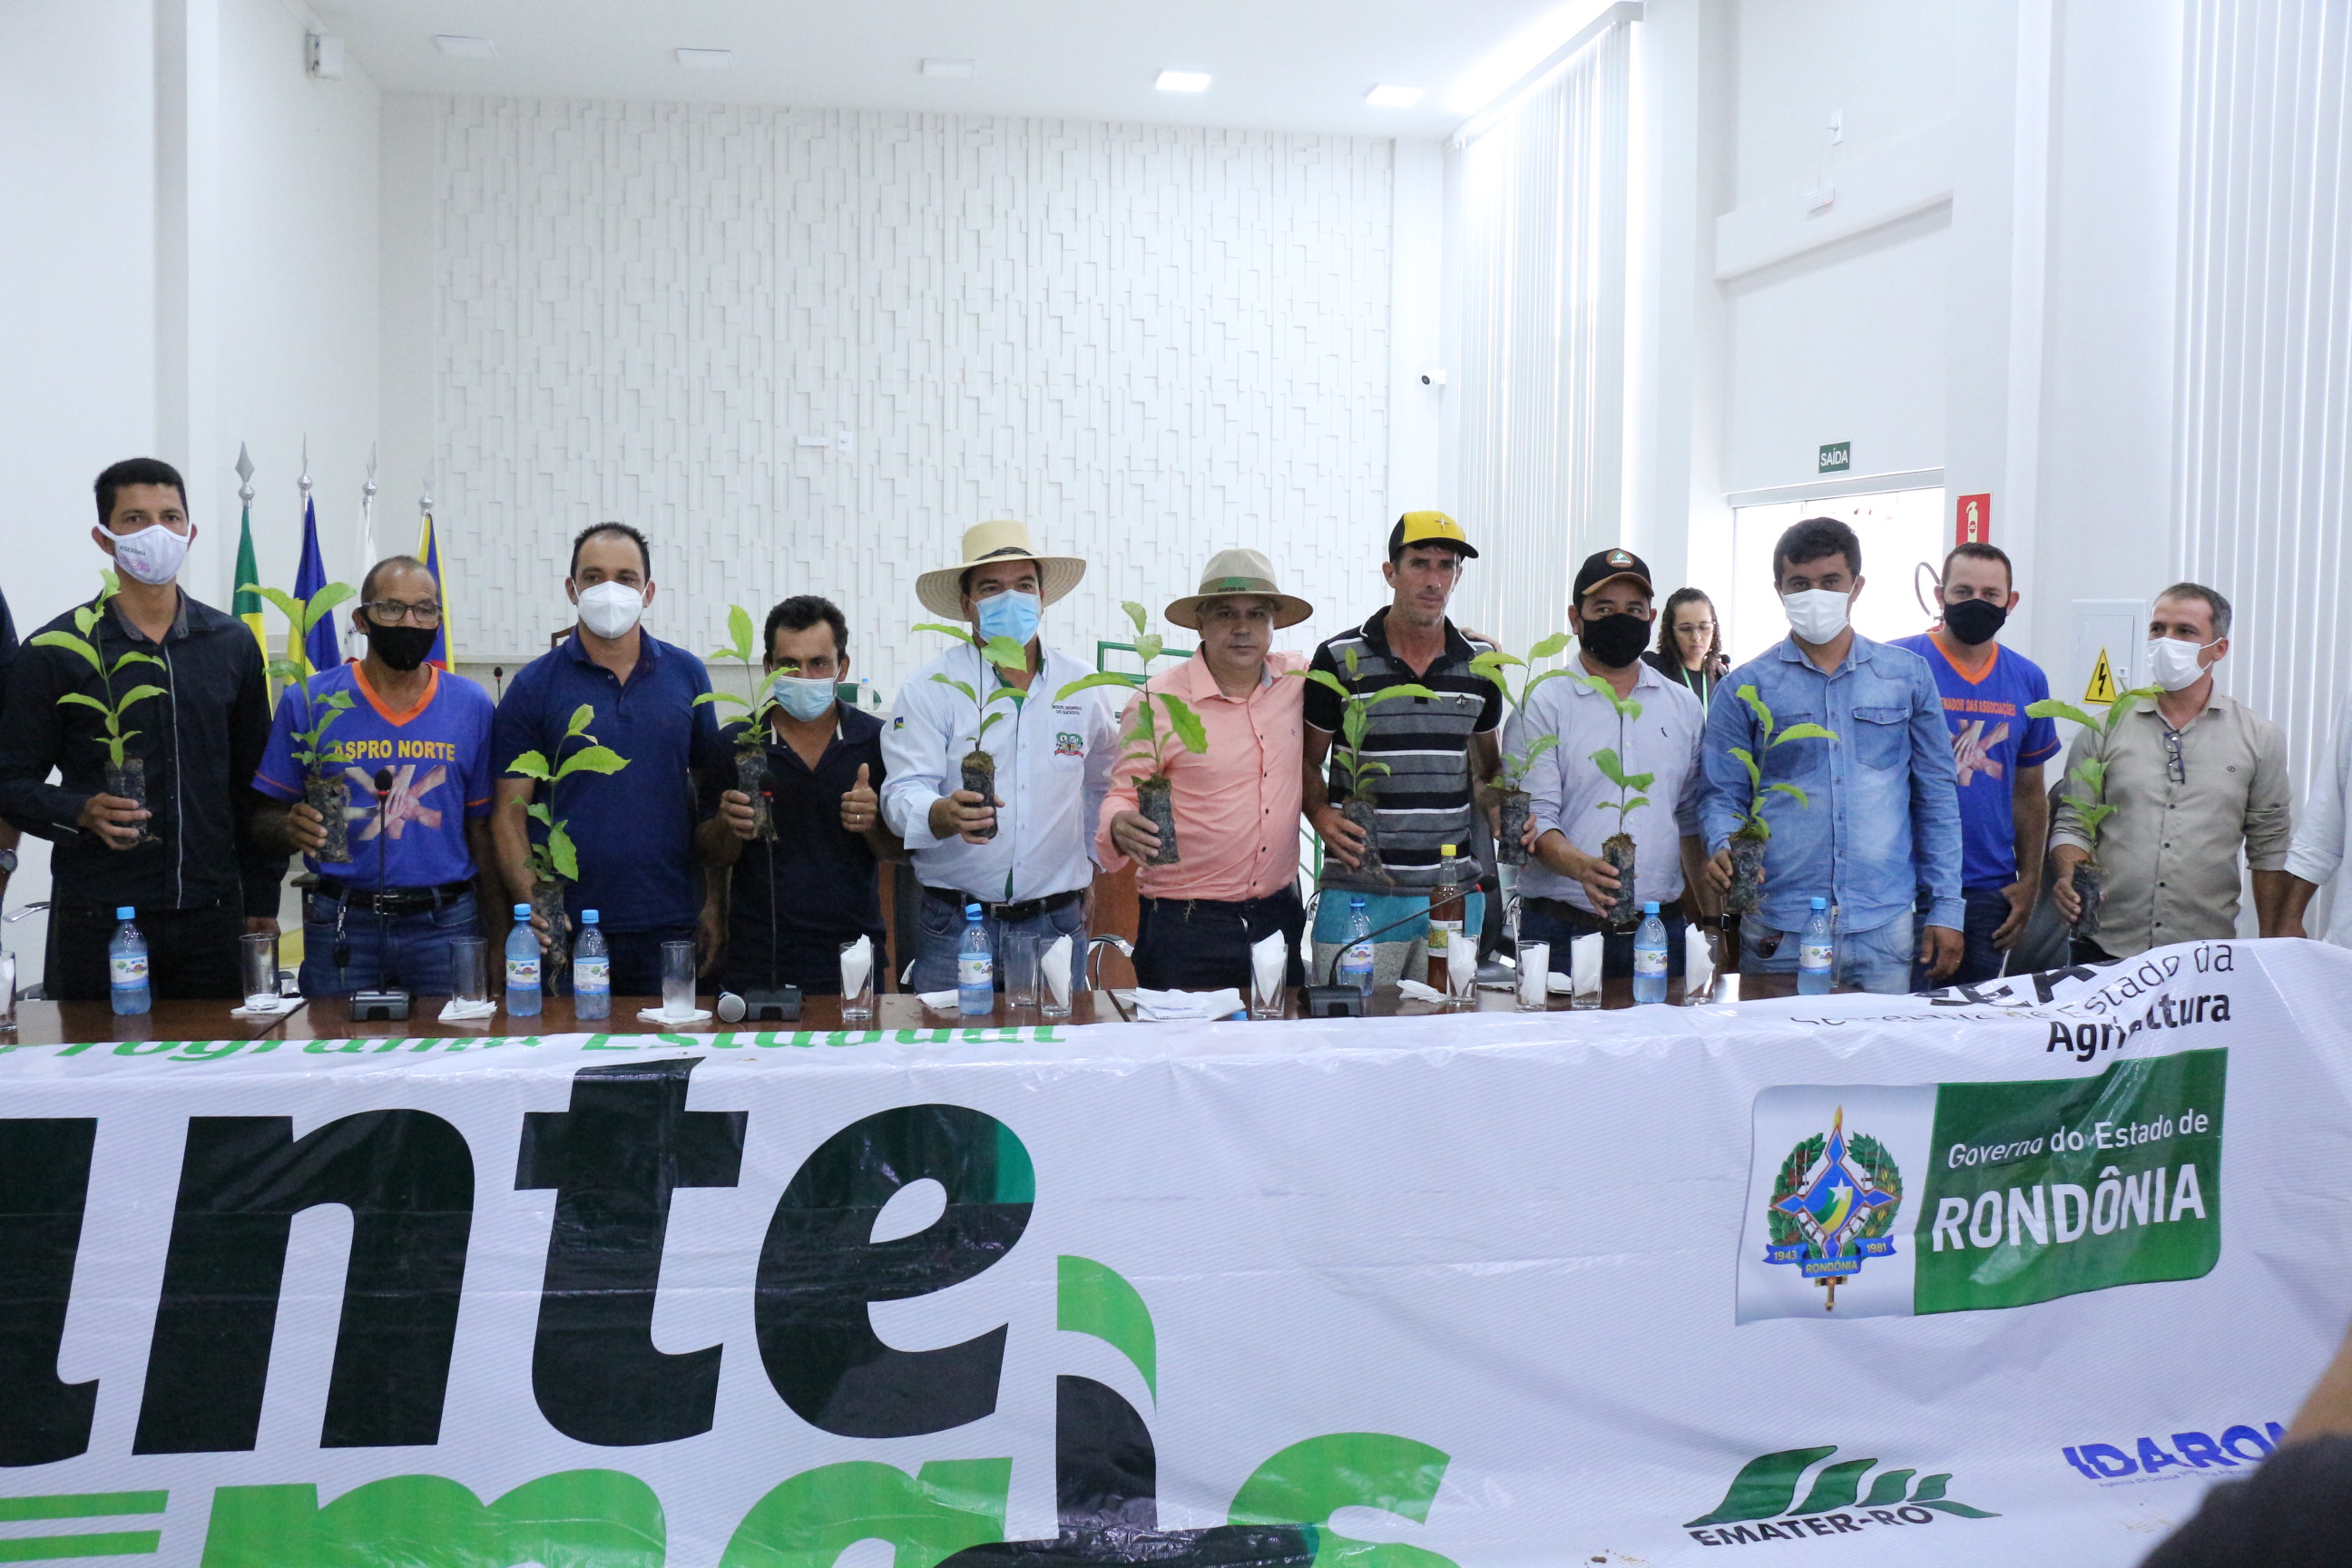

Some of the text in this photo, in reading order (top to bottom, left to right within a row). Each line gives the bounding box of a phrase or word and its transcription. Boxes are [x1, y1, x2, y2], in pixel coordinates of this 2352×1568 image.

[1820, 447, 1848, 466] SAÍDA
[1965, 700, 1978, 712] DAS
[334, 740, 456, 761] ASPRO NORTE
[2056, 955, 2180, 1018] Estado
[2193, 942, 2233, 974] da
[1948, 1108, 2209, 1169] Governo do Estado de
[1932, 1163, 2206, 1252] RONDÔNIA
[1773, 1250, 1798, 1261] 1943
[1866, 1242, 1886, 1253] 1981
[1805, 1260, 1858, 1273] RONDÔNIA
[1689, 1506, 1934, 1546] EMATER-RO
